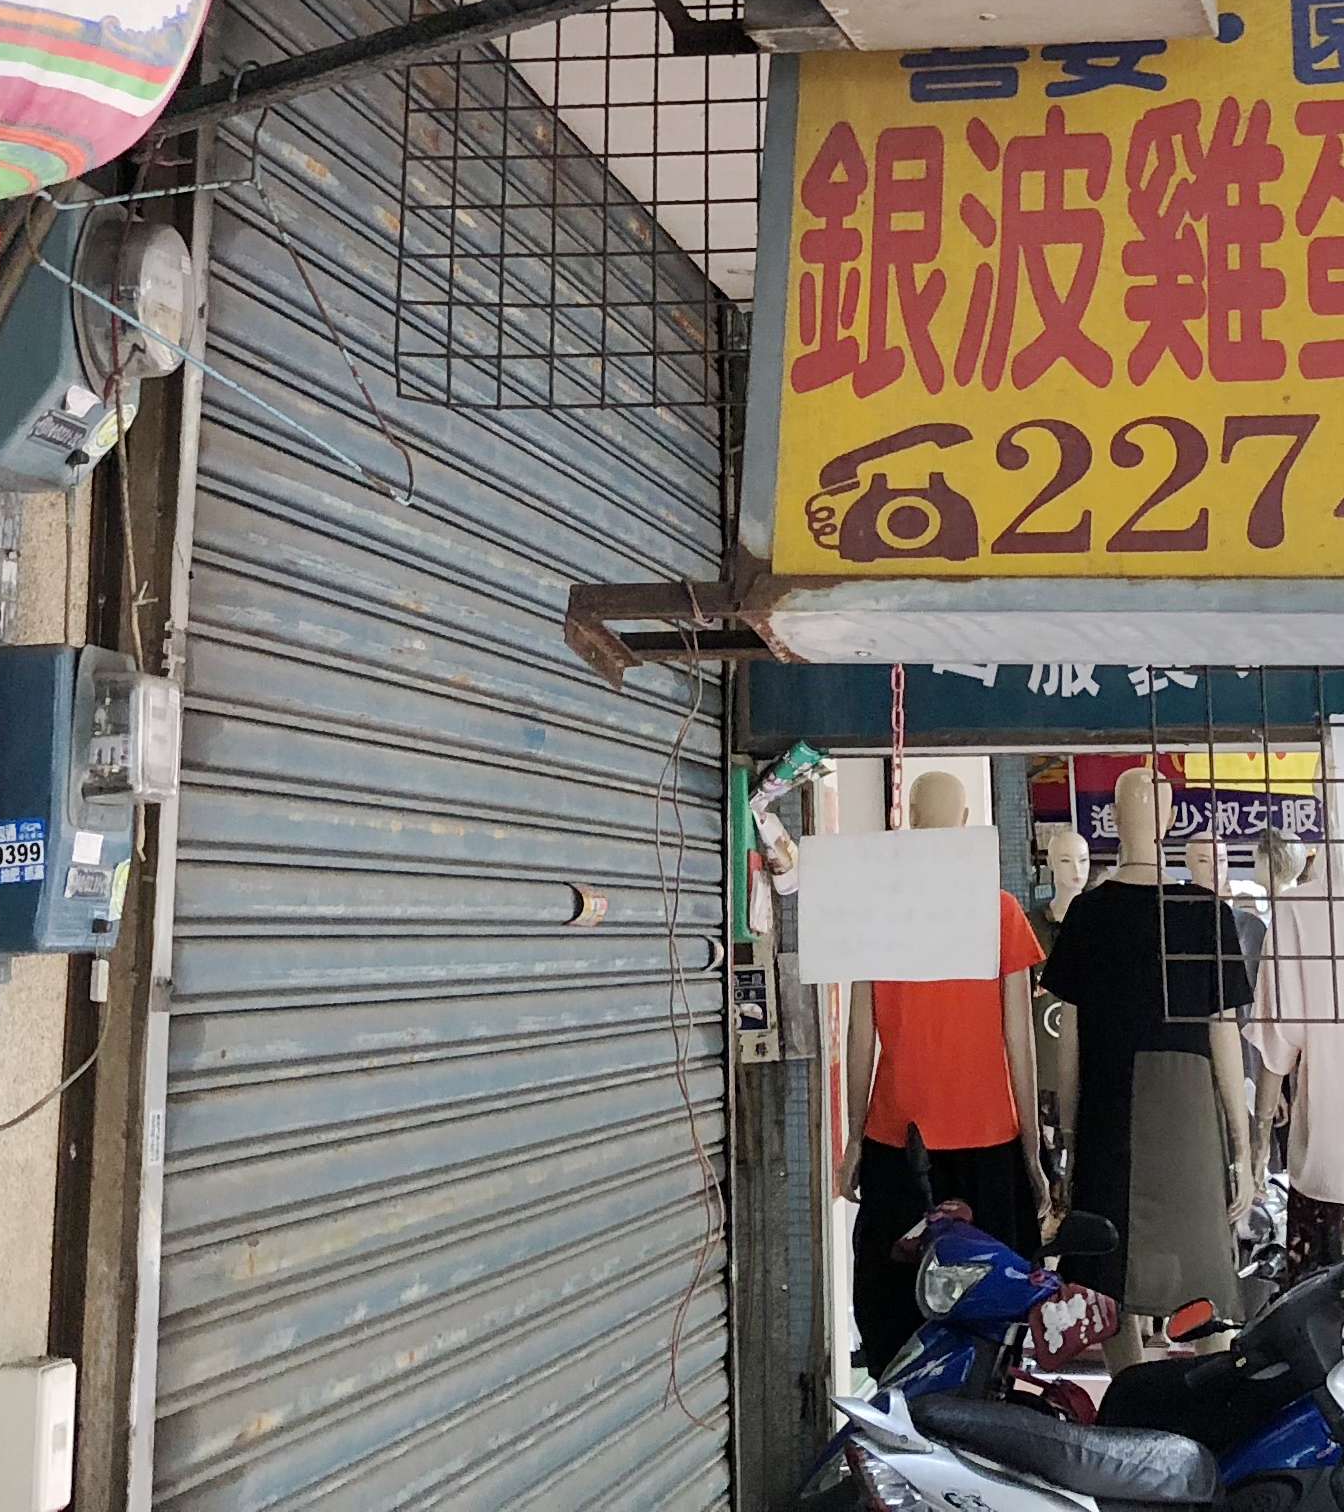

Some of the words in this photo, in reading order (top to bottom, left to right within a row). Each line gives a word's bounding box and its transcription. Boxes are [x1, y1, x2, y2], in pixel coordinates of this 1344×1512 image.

[1090, 799, 1327, 840] 進少淑女服
